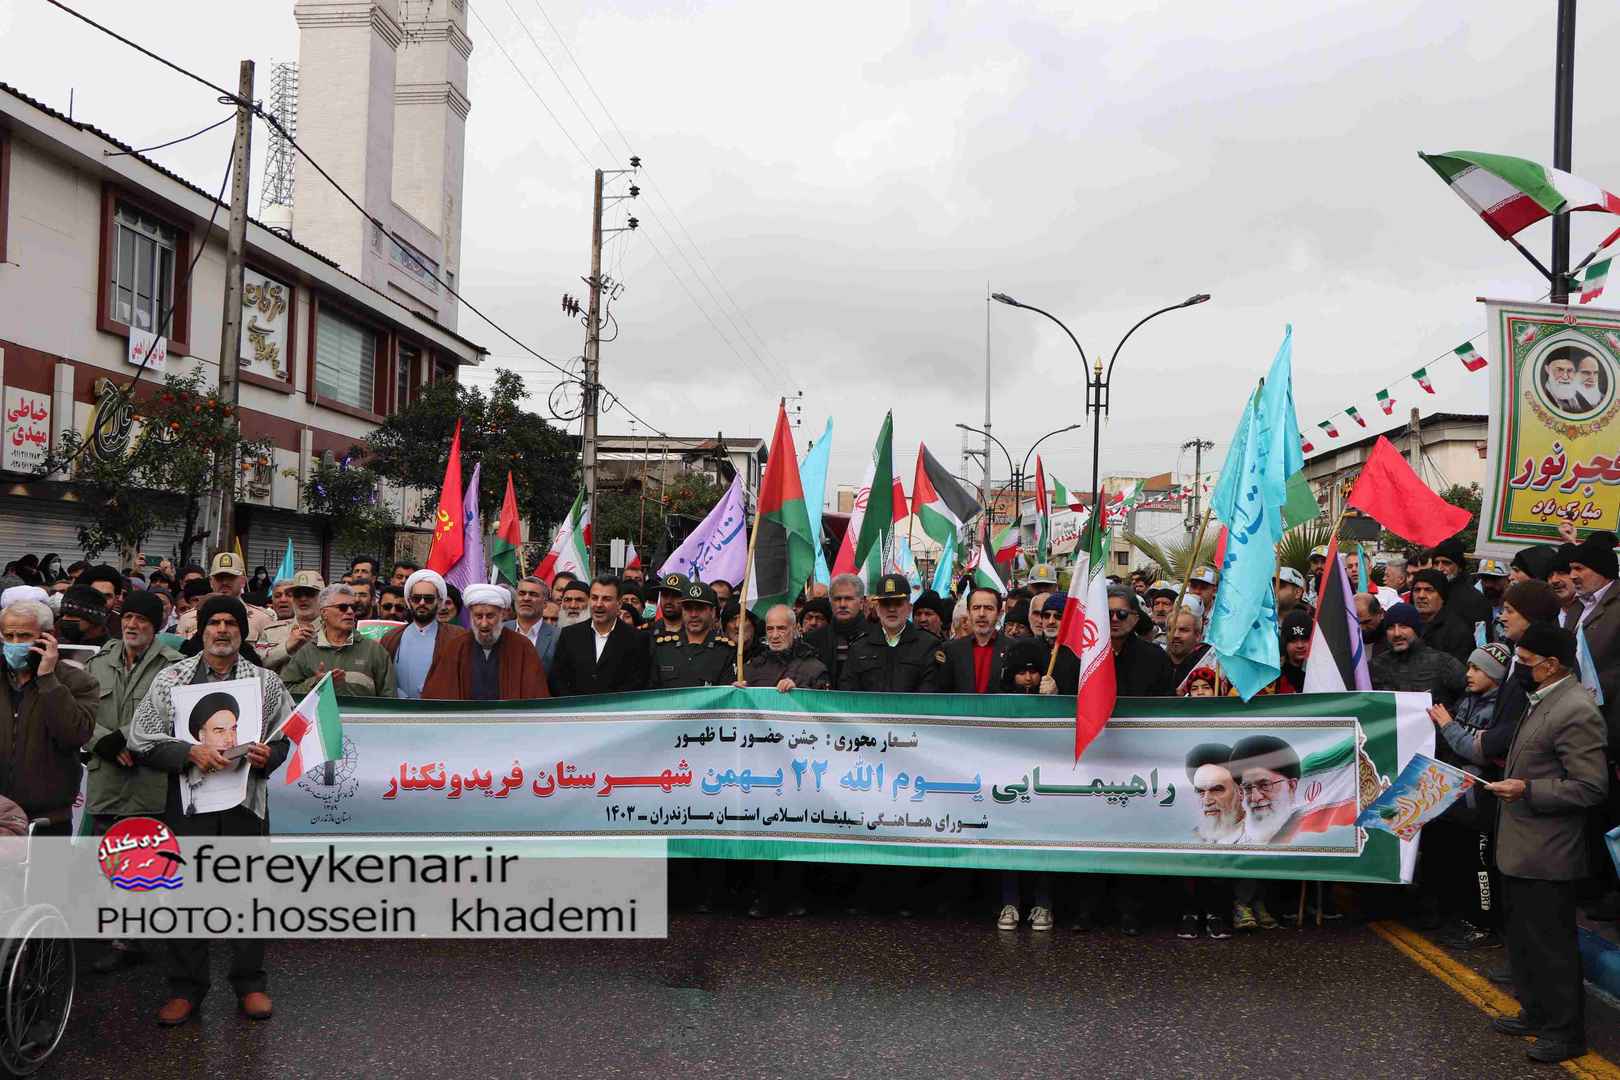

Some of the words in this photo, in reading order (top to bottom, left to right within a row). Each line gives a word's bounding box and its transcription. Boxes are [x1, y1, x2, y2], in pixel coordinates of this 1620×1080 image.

[8, 397, 48, 425] خیاطی
[1510, 441, 1567, 493] نور
[674, 727, 715, 748] ظهور
[719, 726, 737, 742] تا
[740, 730, 784, 748] حضور
[788, 730, 819, 749] جشن
[880, 732, 918, 752] شعار
[382, 759, 525, 799] فریدونکنار
[532, 758, 694, 798] شهرستان
[701, 765, 784, 797] بهمن
[791, 758, 828, 792] ۲۲
[840, 753, 886, 792] الله
[892, 771, 983, 802] یوم
[991, 765, 1176, 808] راهپیمایی
[606, 805, 636, 822] ۱۴۰۳
[650, 805, 714, 825] مازندران
[716, 807, 760, 825] استان
[762, 807, 808, 825] اسلامی
[811, 808, 864, 827] تبلیغات
[867, 812, 932, 831] هماهنگی
[935, 813, 989, 833] شورای
